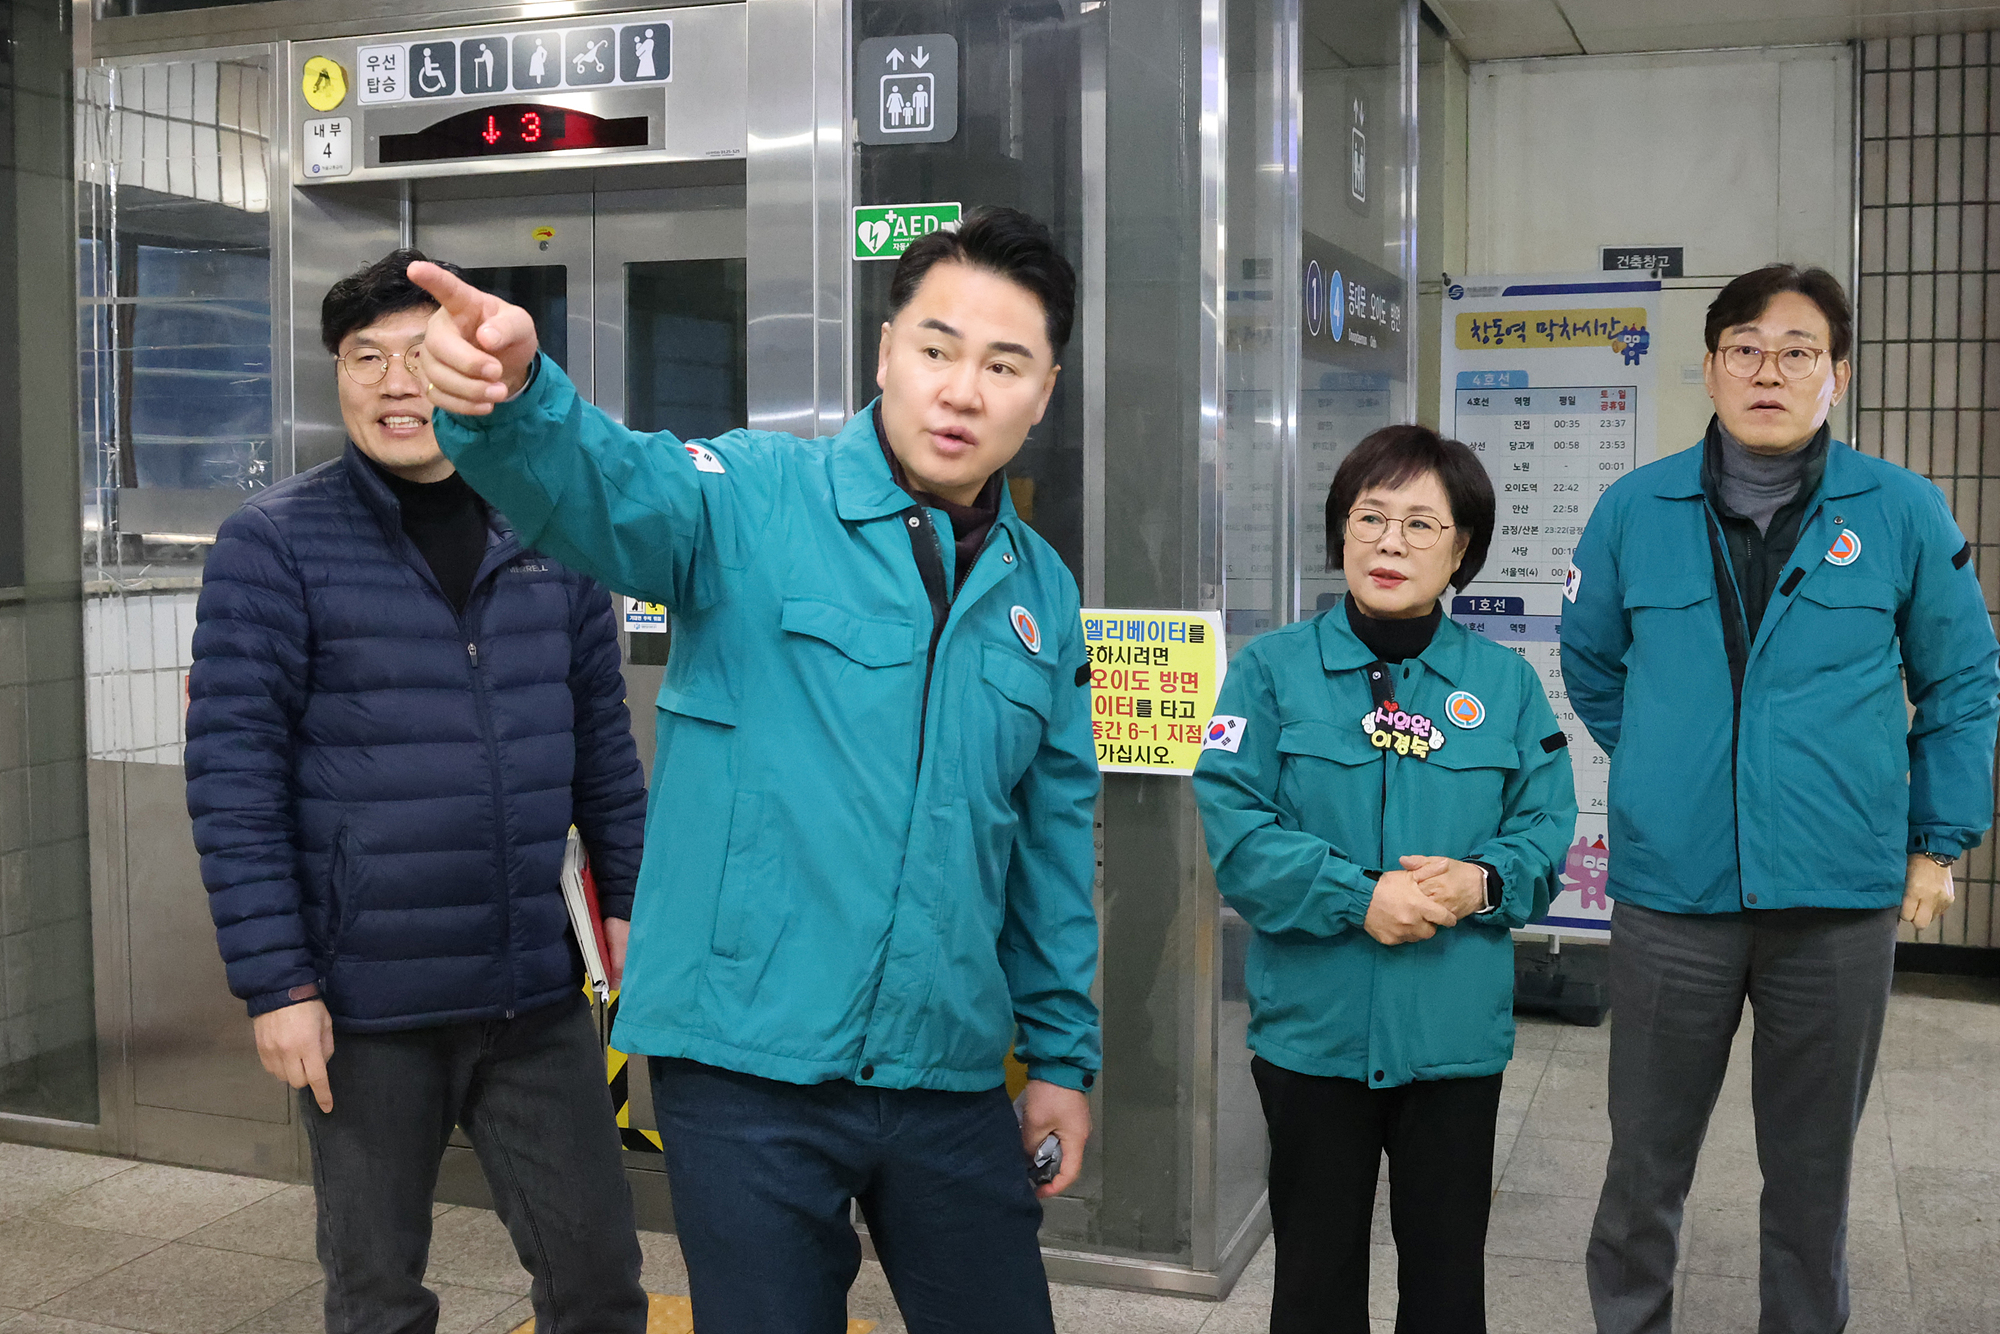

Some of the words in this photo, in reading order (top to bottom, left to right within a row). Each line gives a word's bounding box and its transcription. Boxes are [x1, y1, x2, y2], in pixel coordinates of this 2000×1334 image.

[366, 54, 396, 73] 우선
[366, 76, 397, 94] 탑승
[521, 112, 541, 142] 3
[323, 142, 333, 159] 4
[893, 215, 939, 237] AED
[1616, 255, 1671, 269] 건축창고
[1311, 277, 1317, 320] 1
[1348, 281, 1366, 319] 동대문
[1333, 286, 1340, 327] 4
[1470, 317, 1527, 345] 창동역
[1536, 316, 1622, 343] 막차시간
[1472, 373, 1511, 387] 4호선
[1466, 397, 1490, 407] 4호선
[1514, 396, 1531, 407] 역명
[1559, 396, 1576, 406] 평일
[1600, 401, 1626, 411] 공휴일
[1513, 420, 1531, 430] 진접
[1554, 420, 1580, 428] 00:35
[1600, 419, 1626, 427] 23:37
[1509, 441, 1535, 451] 당고개
[1554, 441, 1580, 449] 00:58
[1600, 440, 1626, 449] 23:53
[1513, 462, 1530, 472] 노원
[1599, 462, 1625, 470] 00:01
[1504, 483, 1538, 493] 오이도역
[1553, 483, 1579, 492] 22:42
[1512, 505, 1529, 514] 안산
[1553, 505, 1579, 513] 22:58
[1501, 525, 1539, 536] 금정/산본
[1544, 526, 1585, 536] 23:22(금정
[1511, 547, 1528, 556] 사당
[1501, 567, 1539, 578] 서울역(4)
[1469, 598, 1506, 613] 1호선
[1085, 619, 1205, 644] 엘리베이터를
[1509, 623, 1526, 634] 역명
[1090, 669, 1150, 691] 오이도
[1160, 671, 1199, 694] 방면
[1095, 695, 1152, 718] 이터를
[1161, 700, 1196, 719] 타고
[1092, 720, 1122, 740] 중간
[1128, 722, 1158, 741] 6-1
[1167, 723, 1202, 744] 지점
[1098, 744, 1174, 765] 가십시오.
[1591, 798, 1608, 807] 24:
